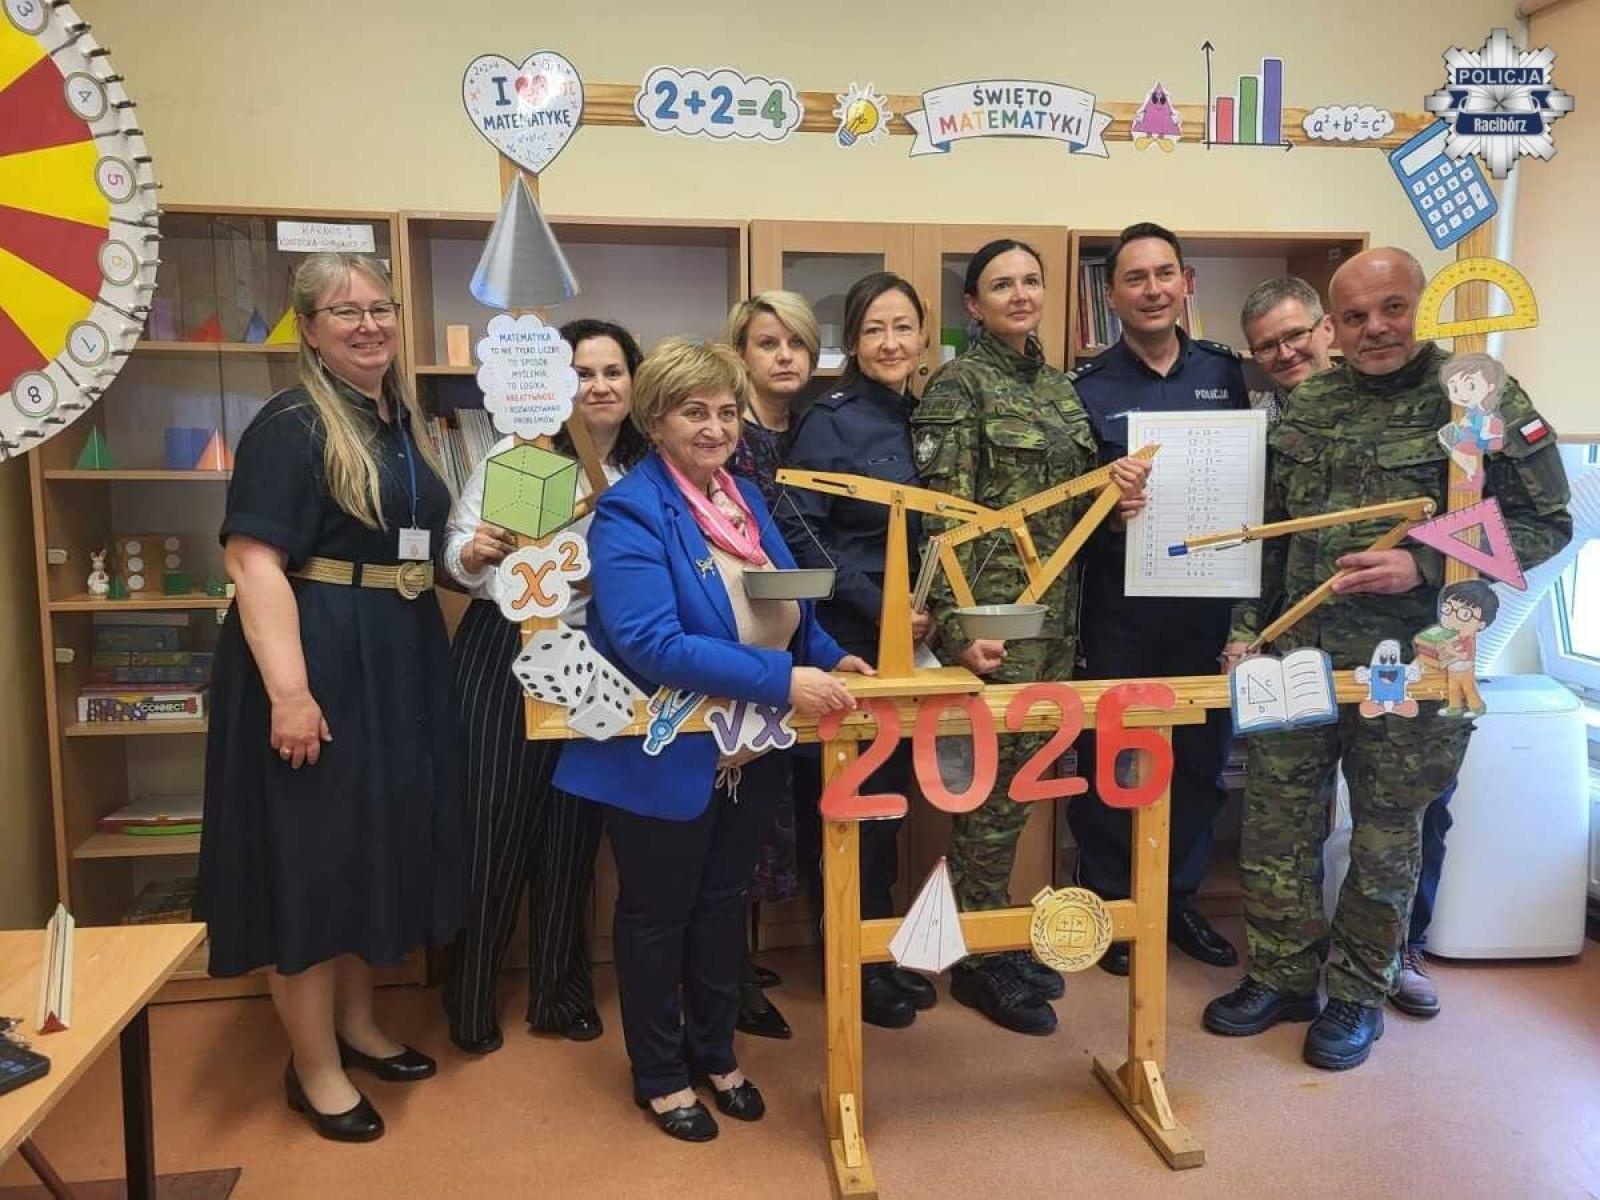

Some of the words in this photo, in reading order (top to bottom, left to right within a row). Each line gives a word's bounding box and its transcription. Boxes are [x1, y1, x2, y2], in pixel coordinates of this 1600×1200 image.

[17, 1, 33, 17] 3
[78, 90, 92, 103] 4
[491, 76, 512, 106] I
[972, 85, 1052, 108] ŚWIĘTO
[939, 109, 1083, 136] MATEMATYKI
[107, 173, 124, 186] 5
[80, 336, 97, 354] 7
[500, 332, 551, 342] MATEMATYKA
[27, 385, 42, 404] 8
[1194, 388, 1228, 400] POLICJA
[141, 703, 184, 713] CONNECT
[817, 682, 1176, 821] 2026
